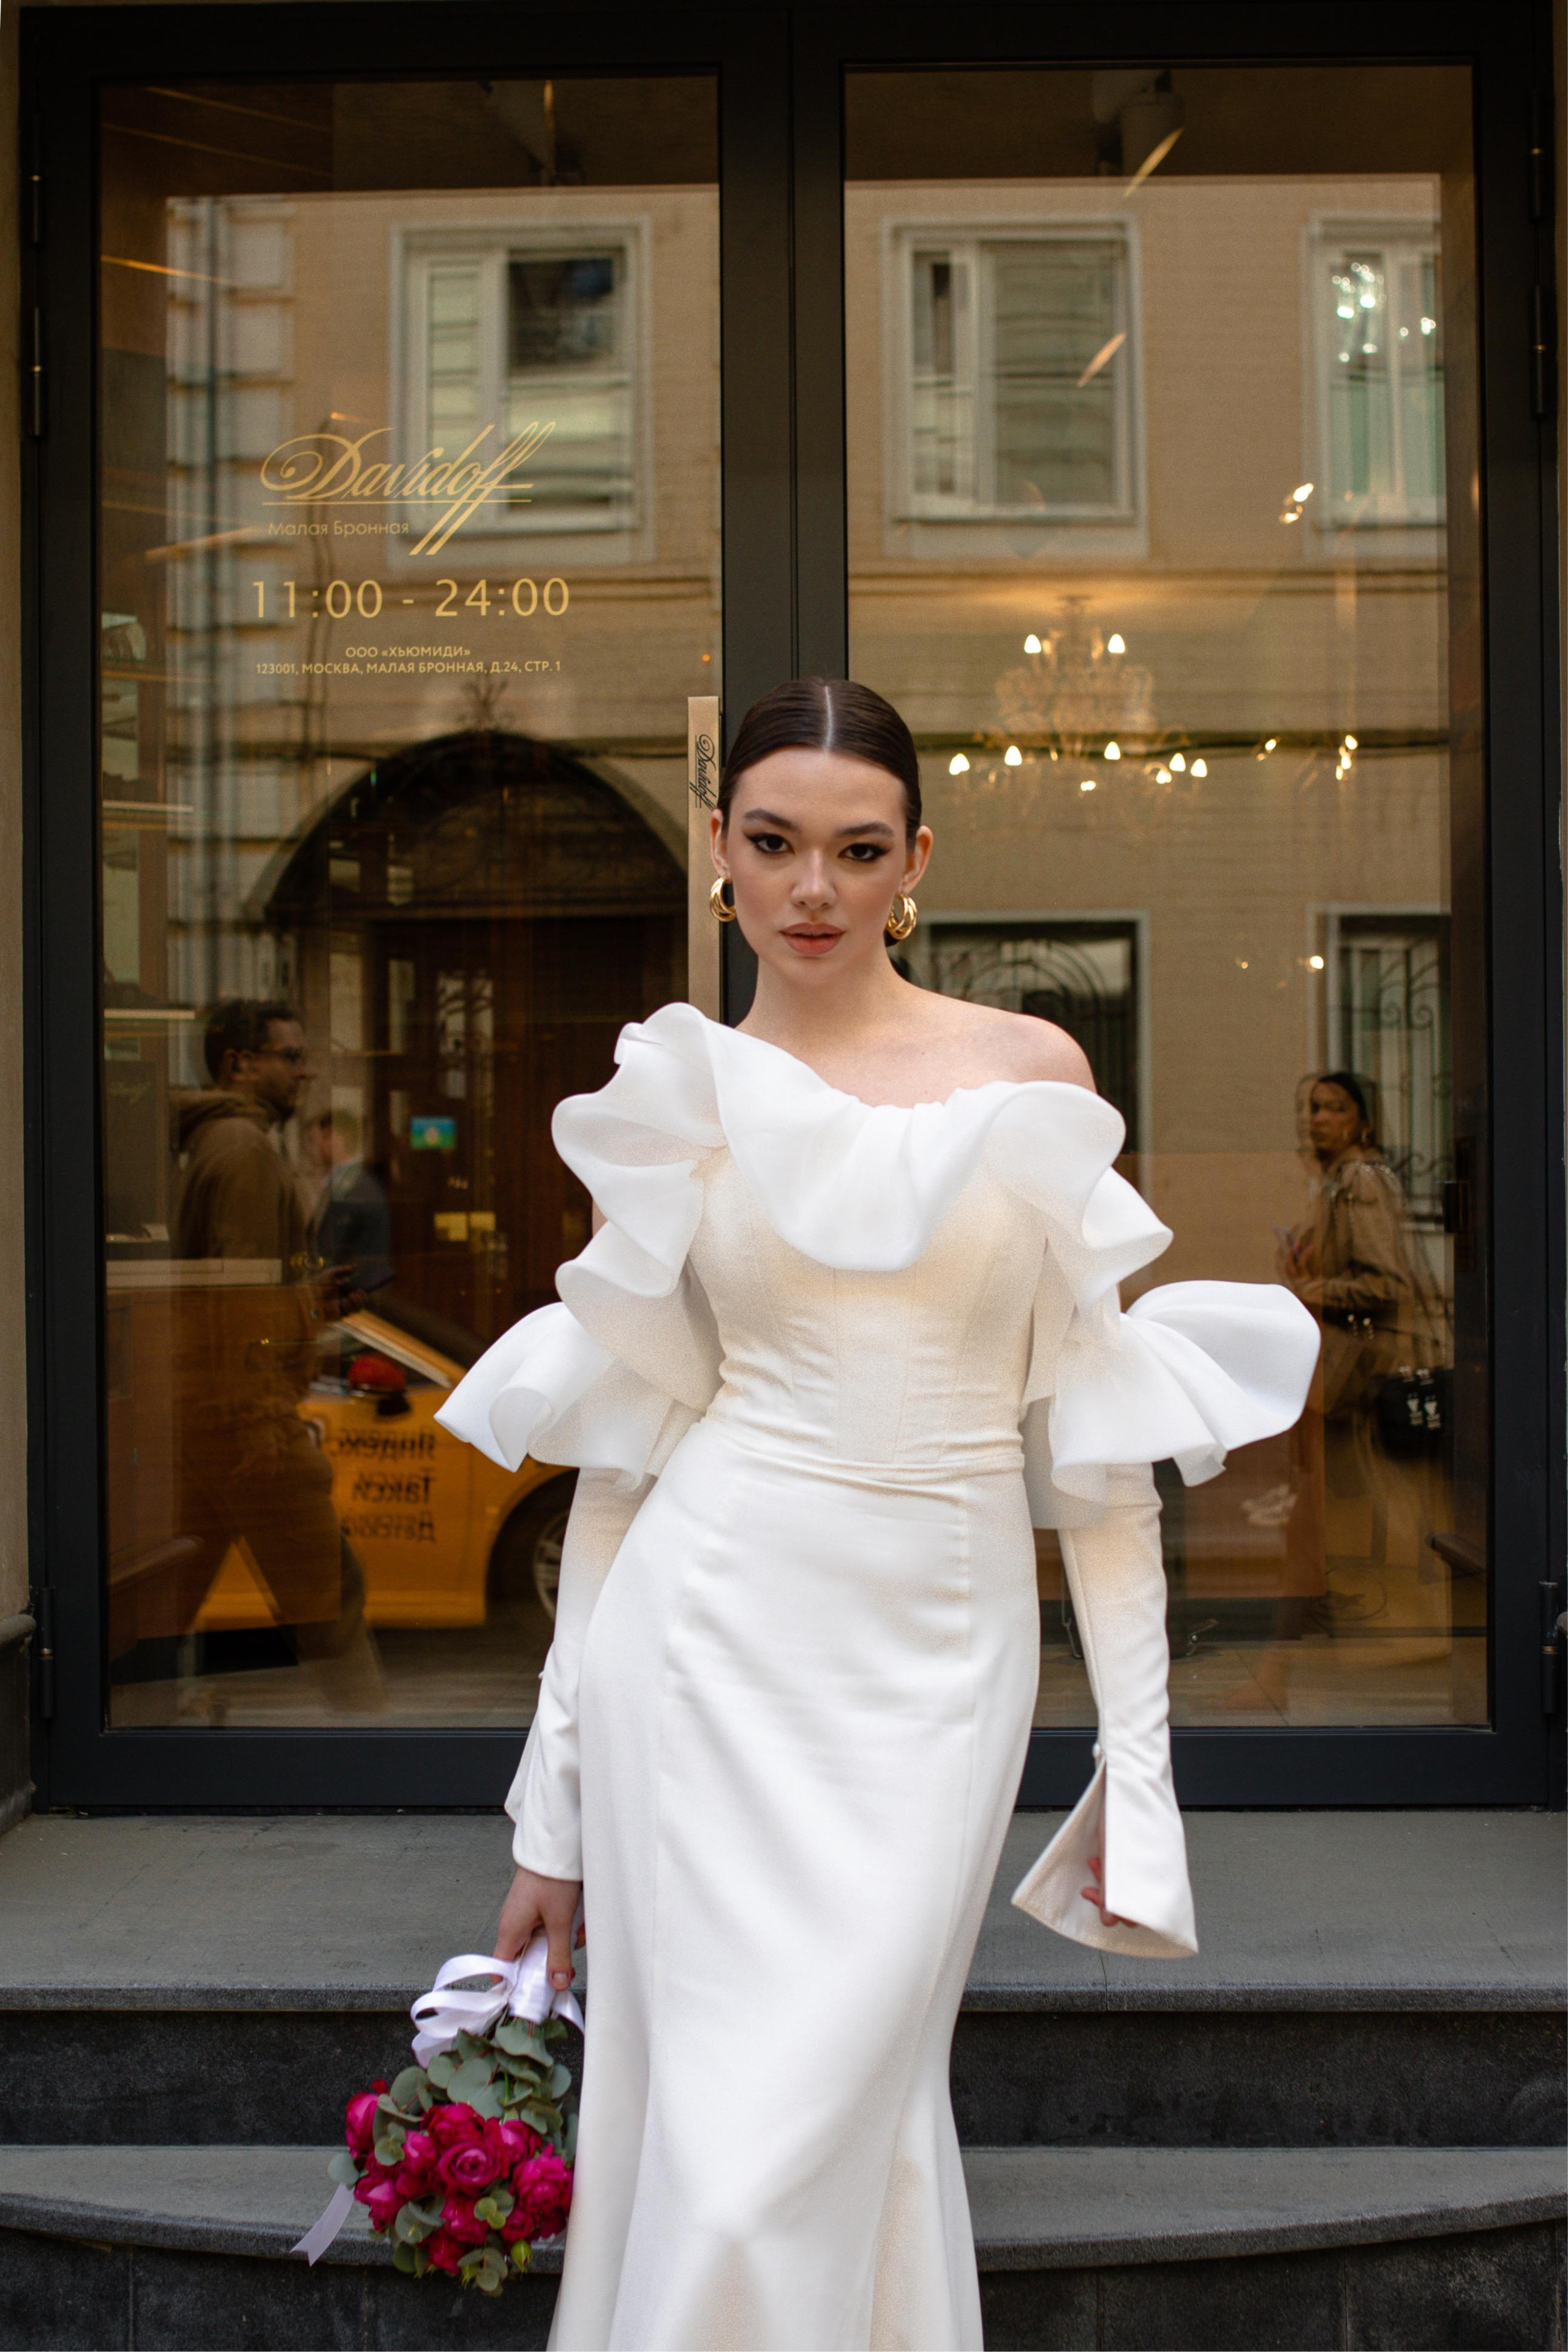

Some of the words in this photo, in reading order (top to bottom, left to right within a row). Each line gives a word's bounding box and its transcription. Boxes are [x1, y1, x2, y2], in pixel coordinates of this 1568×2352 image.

[260, 421, 556, 555] Davidoff
[268, 521, 328, 535] Малая
[334, 520, 409, 535] Бронная
[253, 580, 383, 619] 11:00
[435, 578, 570, 617] 24:00
[345, 647, 378, 657] ООО
[382, 646, 470, 658] «ХЬЮМИДИ»
[257, 663, 299, 675] 123001,
[302, 663, 363, 674] МОСКВА,
[367, 663, 415, 674] МАЛАЯ
[418, 662, 488, 674] БРОННАЯ,
[491, 661, 521, 674] Д.24,
[524, 661, 552, 672] СТР.
[556, 661, 561, 671] 1
[690, 734, 717, 811] Davidoff
